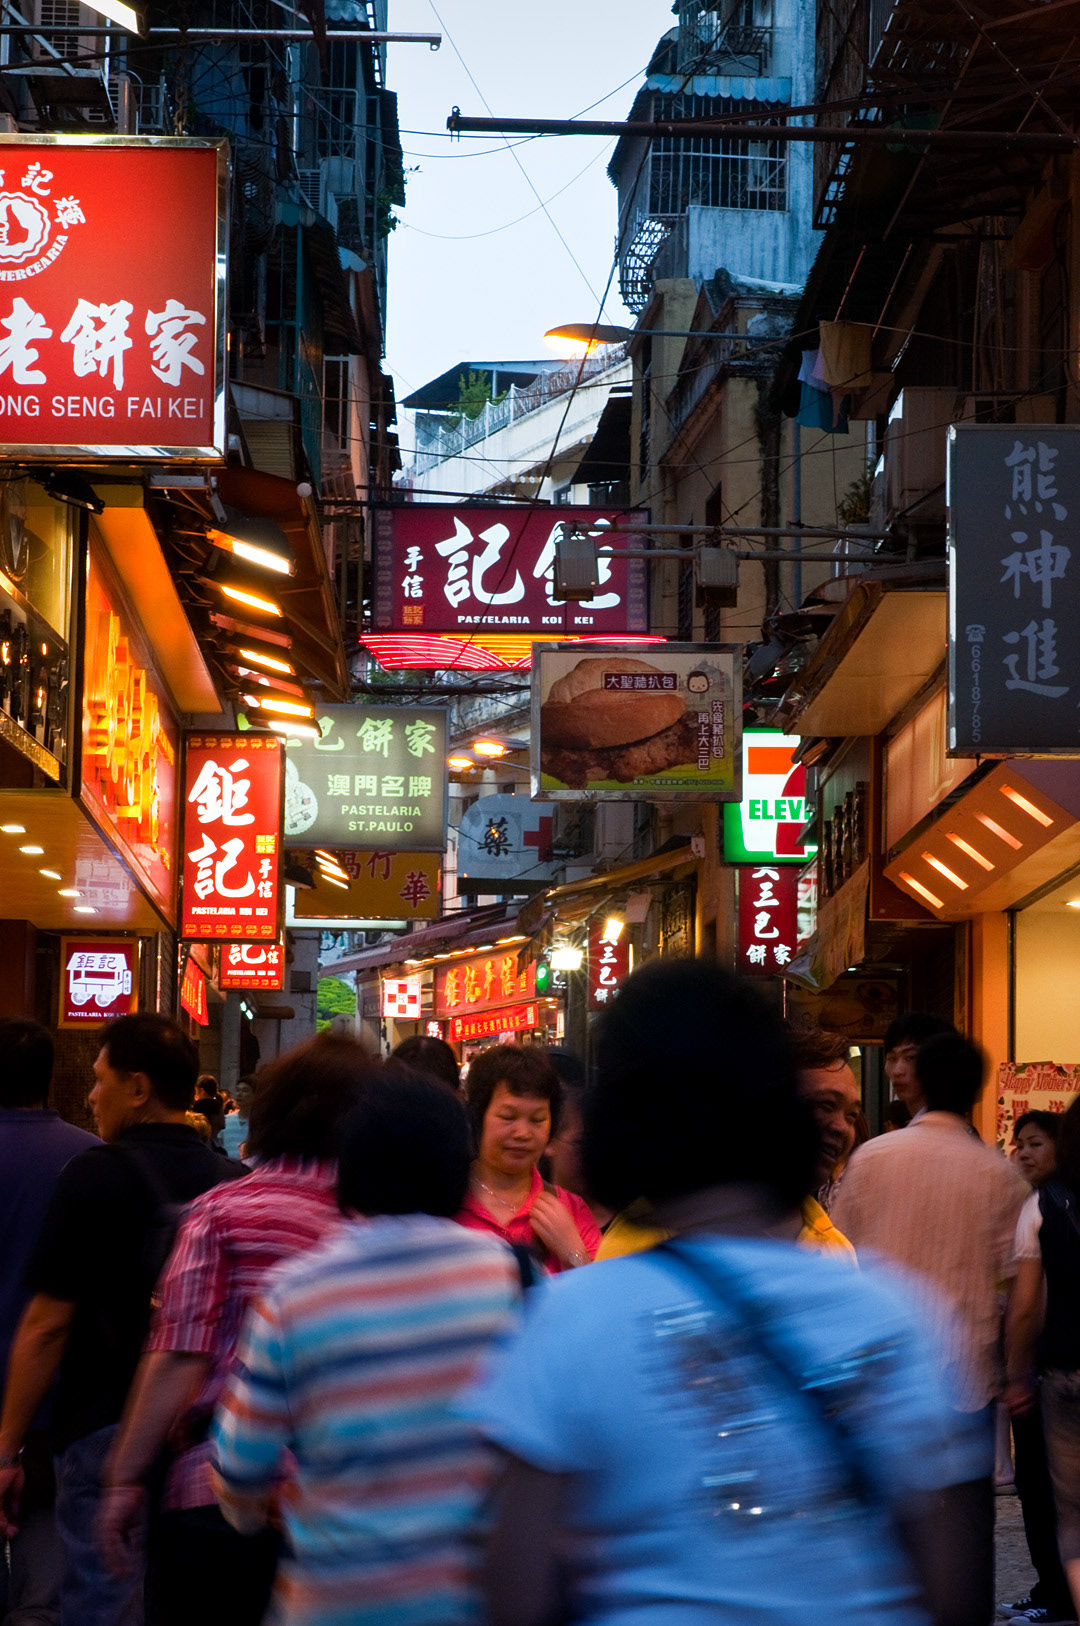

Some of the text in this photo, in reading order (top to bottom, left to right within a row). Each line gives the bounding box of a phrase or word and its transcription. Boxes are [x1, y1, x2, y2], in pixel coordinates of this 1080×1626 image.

[0, 297, 206, 391] 老餅家
[51, 396, 115, 417] SENG
[127, 397, 161, 418] FAI
[168, 398, 204, 418] KEI
[401, 546, 424, 598] 手信
[1000, 441, 1071, 698] 熊神進
[457, 615, 594, 625] PASTELARIA KOI KEI
[971, 645, 982, 743] 6618785
[698, 712, 709, 770] 再上大三巴
[327, 774, 432, 797] 澳門名牌
[341, 804, 421, 816] PASTELARIA
[749, 799, 811, 820] ELEV
[188, 758, 256, 900] 鉅記
[348, 821, 413, 832] ST.PAULO
[477, 817, 513, 857] 藥
[257, 858, 273, 898] 手信
[191, 907, 236, 915] PASTELARIA
[76, 954, 118, 970] 鉅記
[746, 943, 792, 966] 餅家
[1003, 1071, 1033, 1094] Happy
[1034, 1072, 1073, 1092] Mother's
